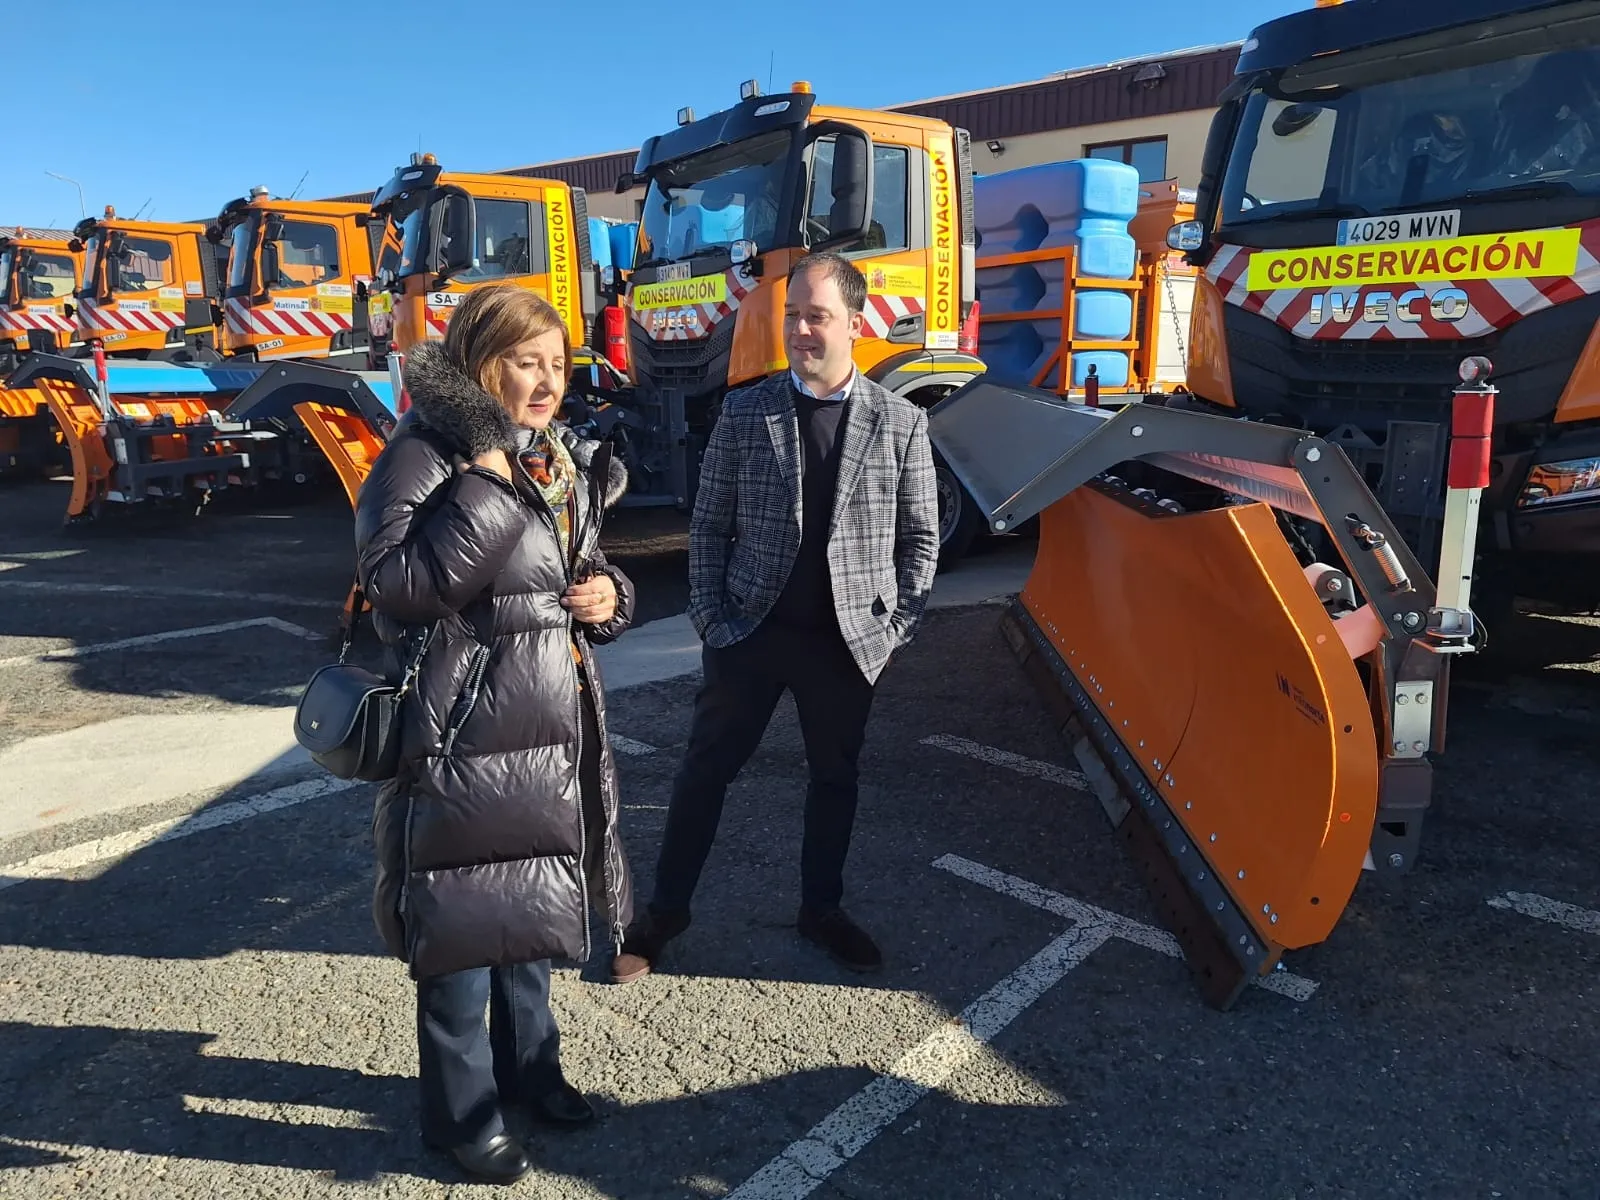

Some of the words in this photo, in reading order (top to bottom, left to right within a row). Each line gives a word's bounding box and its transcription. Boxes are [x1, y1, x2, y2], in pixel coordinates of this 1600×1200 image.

[932, 150, 949, 329] CONSERVACIÓN
[1350, 220, 1400, 242] 4029
[1409, 214, 1454, 238] MVN
[549, 201, 567, 319] ONSERVACIÓN
[1267, 236, 1544, 283] CONSERVACIÓN
[274, 301, 306, 309] Matinsa
[639, 278, 716, 306] CONSERVACIÓN
[652, 308, 698, 331] IVECO
[1309, 288, 1470, 325] IVECO
[258, 340, 282, 349] SA-01
